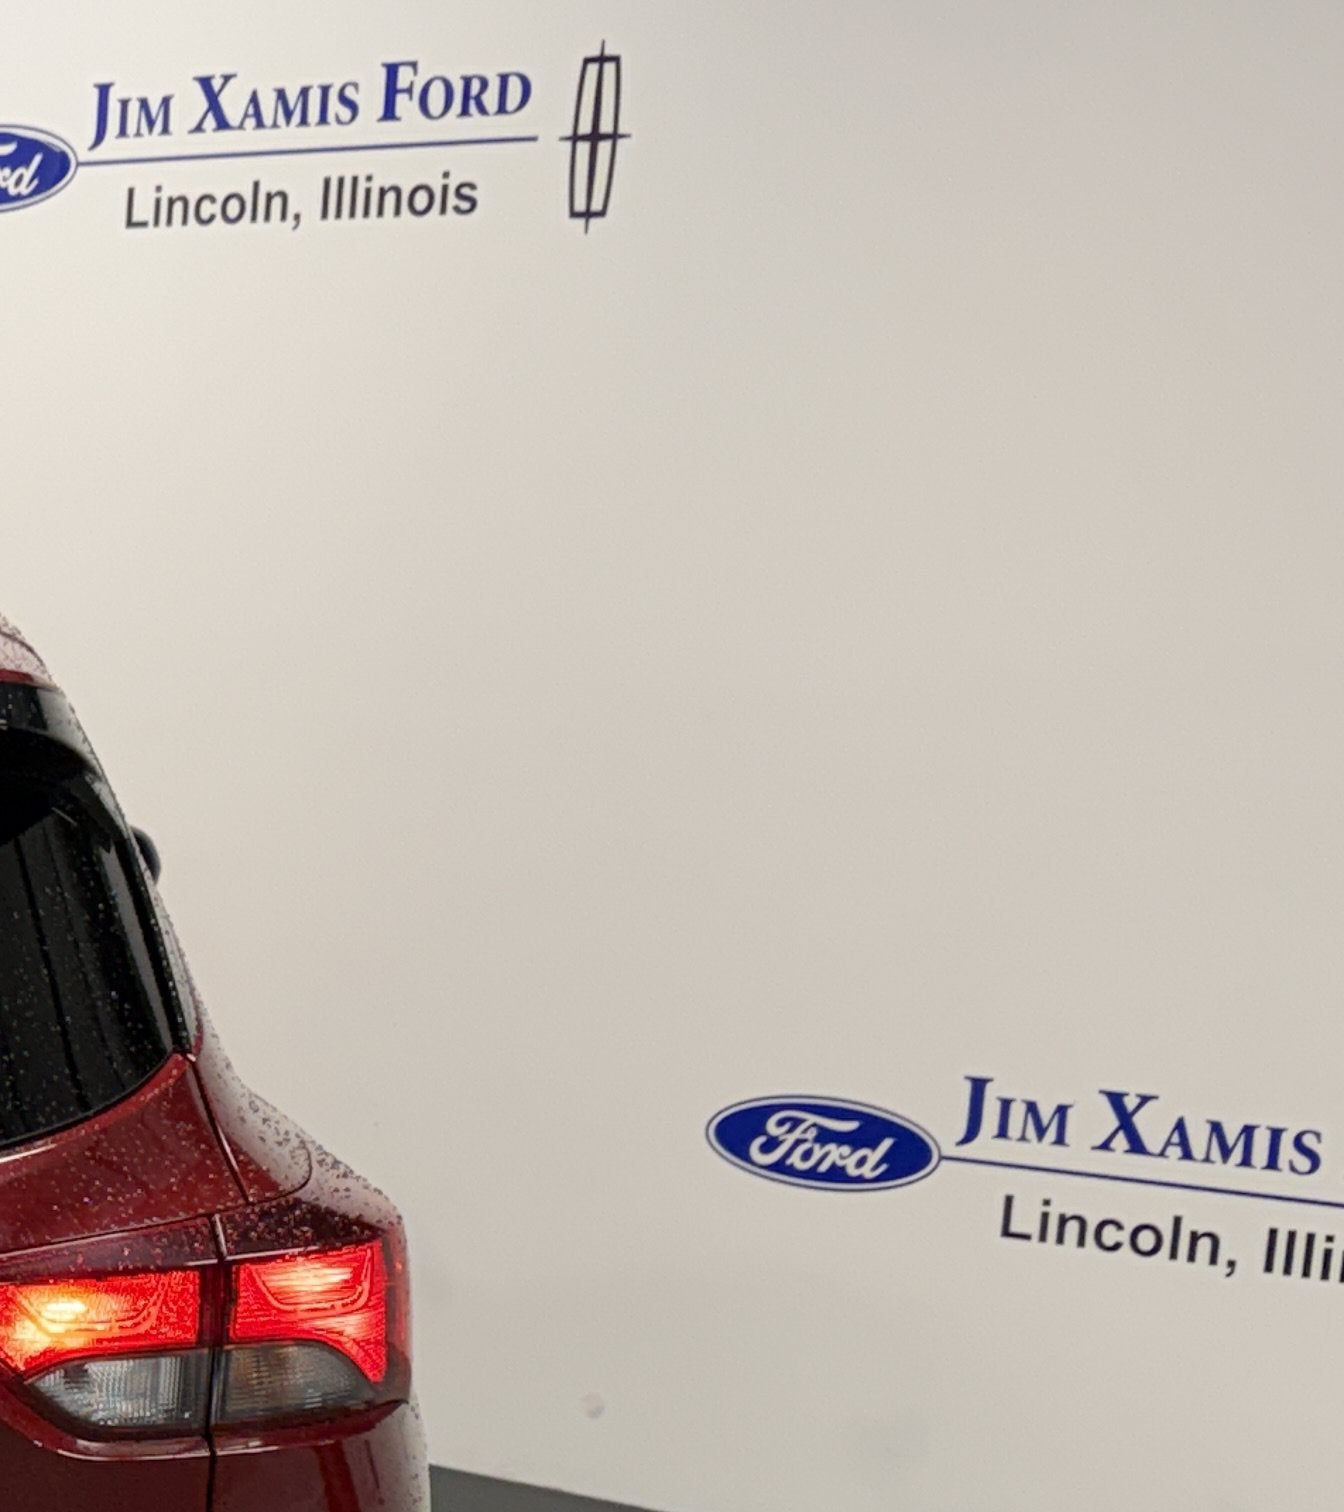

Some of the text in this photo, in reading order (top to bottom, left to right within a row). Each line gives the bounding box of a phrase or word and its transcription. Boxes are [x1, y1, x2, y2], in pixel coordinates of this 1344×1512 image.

[87, 60, 532, 151] JIM XAMIS FORD
[125, 170, 478, 231] Lincoln, Illinois
[749, 1110, 894, 1180] Ford
[955, 1076, 1323, 1177] JIM XAMIS
[1000, 1194, 1344, 1284] Lincoln, Illi
